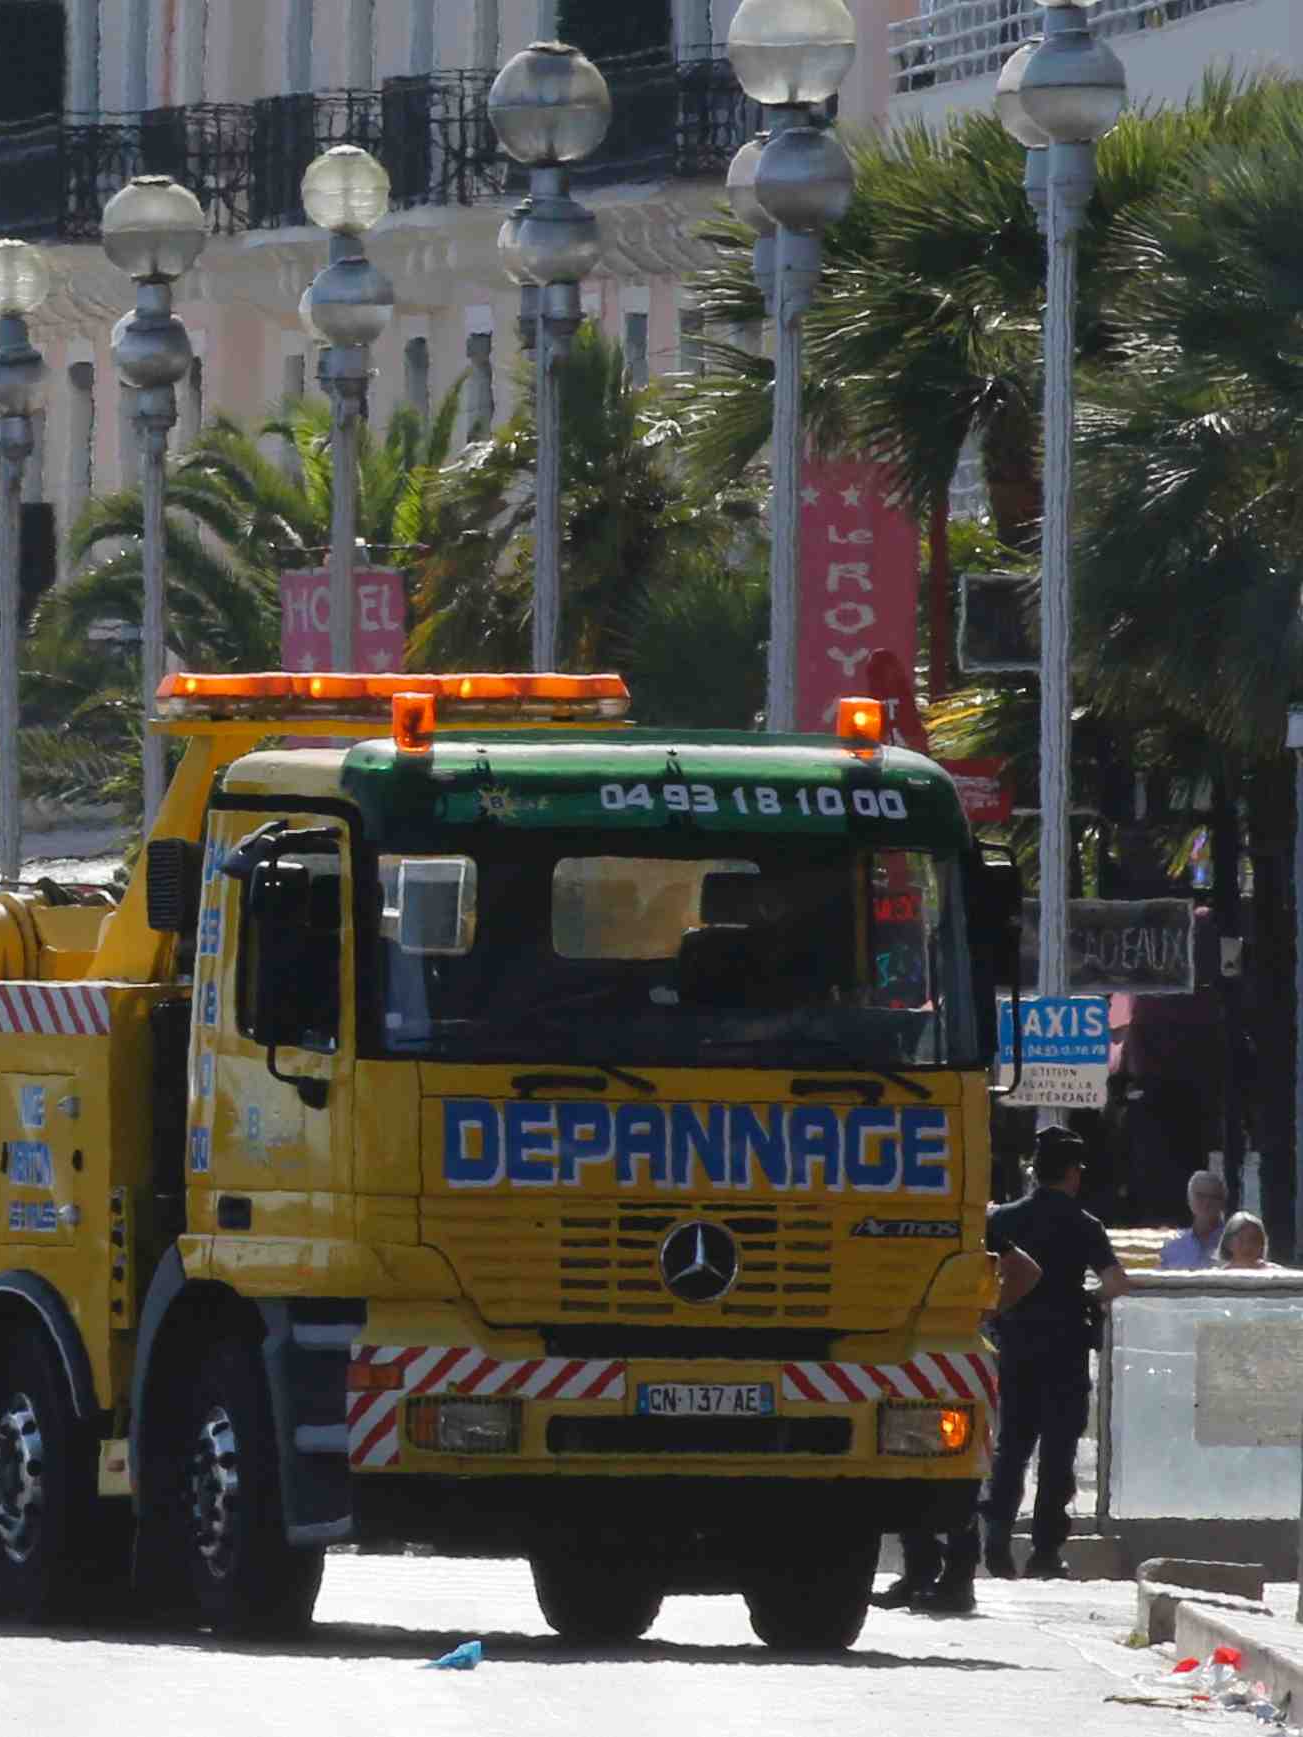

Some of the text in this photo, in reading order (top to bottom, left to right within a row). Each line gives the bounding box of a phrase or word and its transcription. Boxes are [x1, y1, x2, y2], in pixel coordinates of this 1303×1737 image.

[281, 584, 400, 633] HOEL
[600, 784, 655, 811] 04
[663, 784, 719, 814] 93
[732, 786, 783, 816] 18
[443, 1098, 950, 1194] DEPANNAGE
